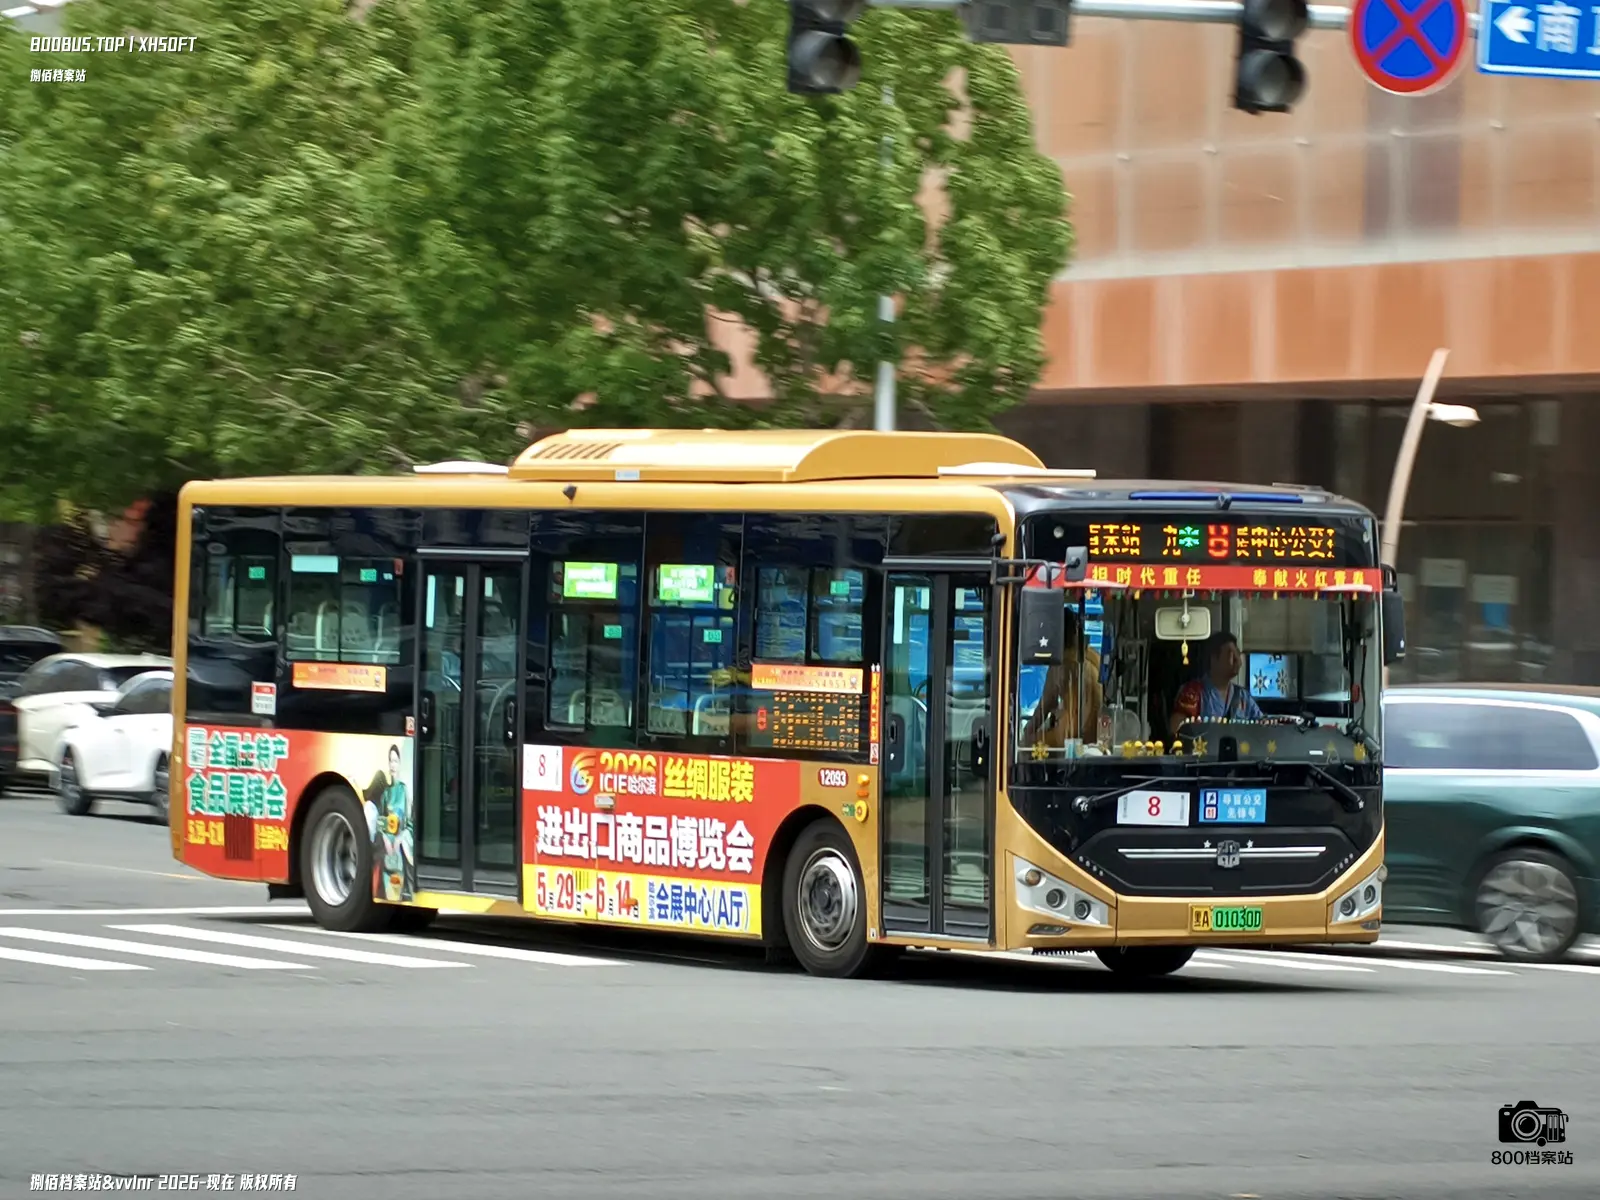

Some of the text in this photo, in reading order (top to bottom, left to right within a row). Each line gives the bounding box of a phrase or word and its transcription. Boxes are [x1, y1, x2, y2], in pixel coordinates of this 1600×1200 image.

[538, 754, 546, 777] 8
[663, 757, 755, 803] 丝绸服装
[820, 769, 847, 787] 12093
[1147, 795, 1161, 817] 8
[535, 805, 755, 873] 进出口商品博览会
